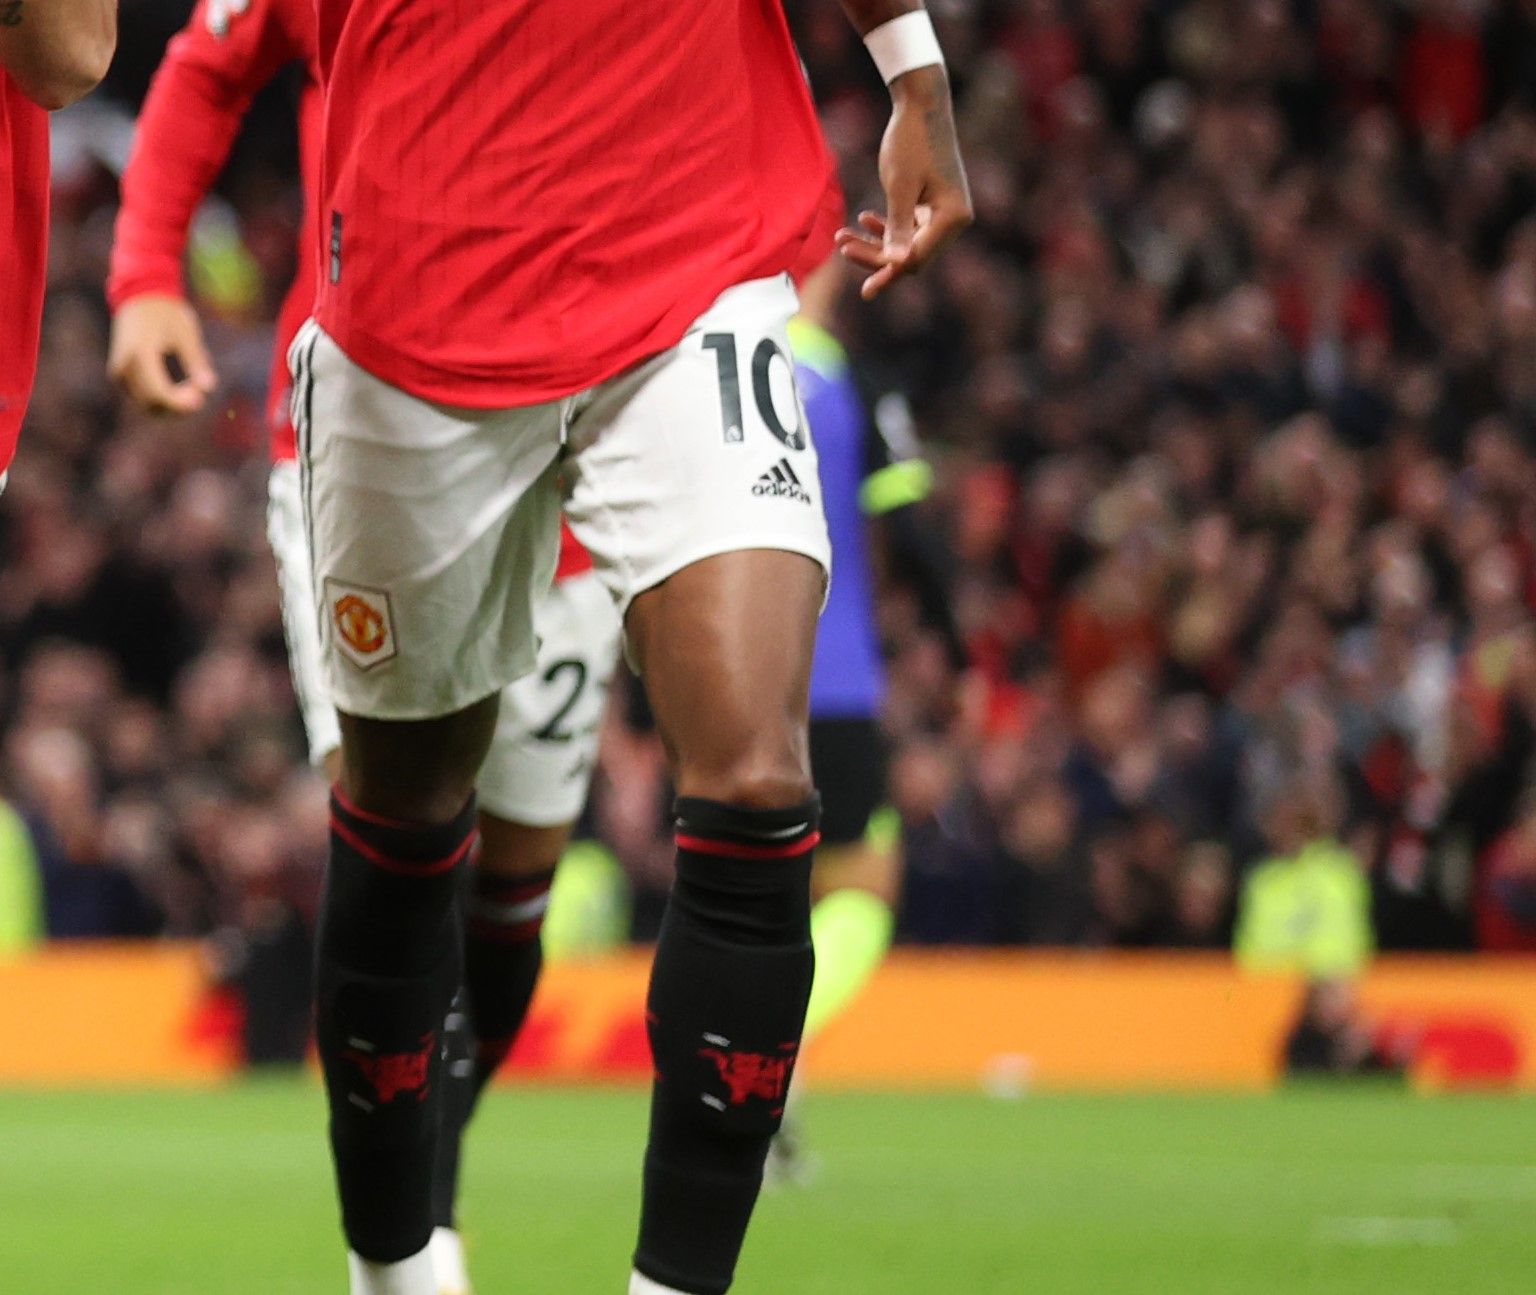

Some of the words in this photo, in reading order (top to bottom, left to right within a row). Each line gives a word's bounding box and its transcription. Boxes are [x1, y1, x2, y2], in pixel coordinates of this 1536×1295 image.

[701, 333, 806, 451] 10
[751, 482, 812, 506] adidas
[530, 660, 608, 740] 2
